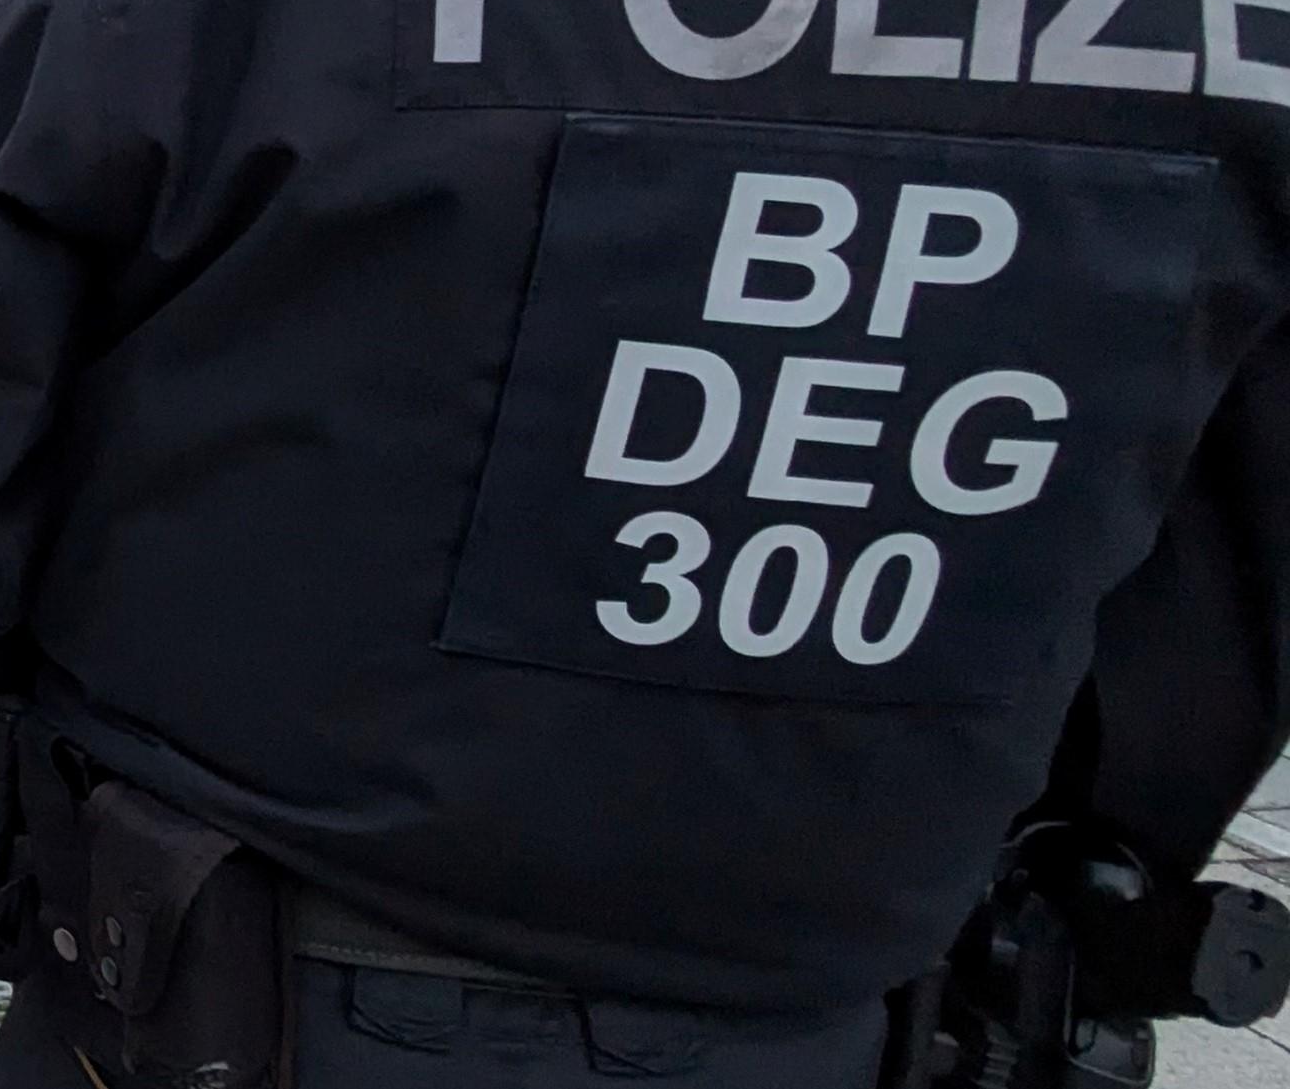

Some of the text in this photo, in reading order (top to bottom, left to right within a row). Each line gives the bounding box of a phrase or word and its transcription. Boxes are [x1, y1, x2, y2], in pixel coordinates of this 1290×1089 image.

[702, 172, 1019, 338] BP
[584, 339, 1069, 516] DEG
[595, 510, 942, 666] 300
